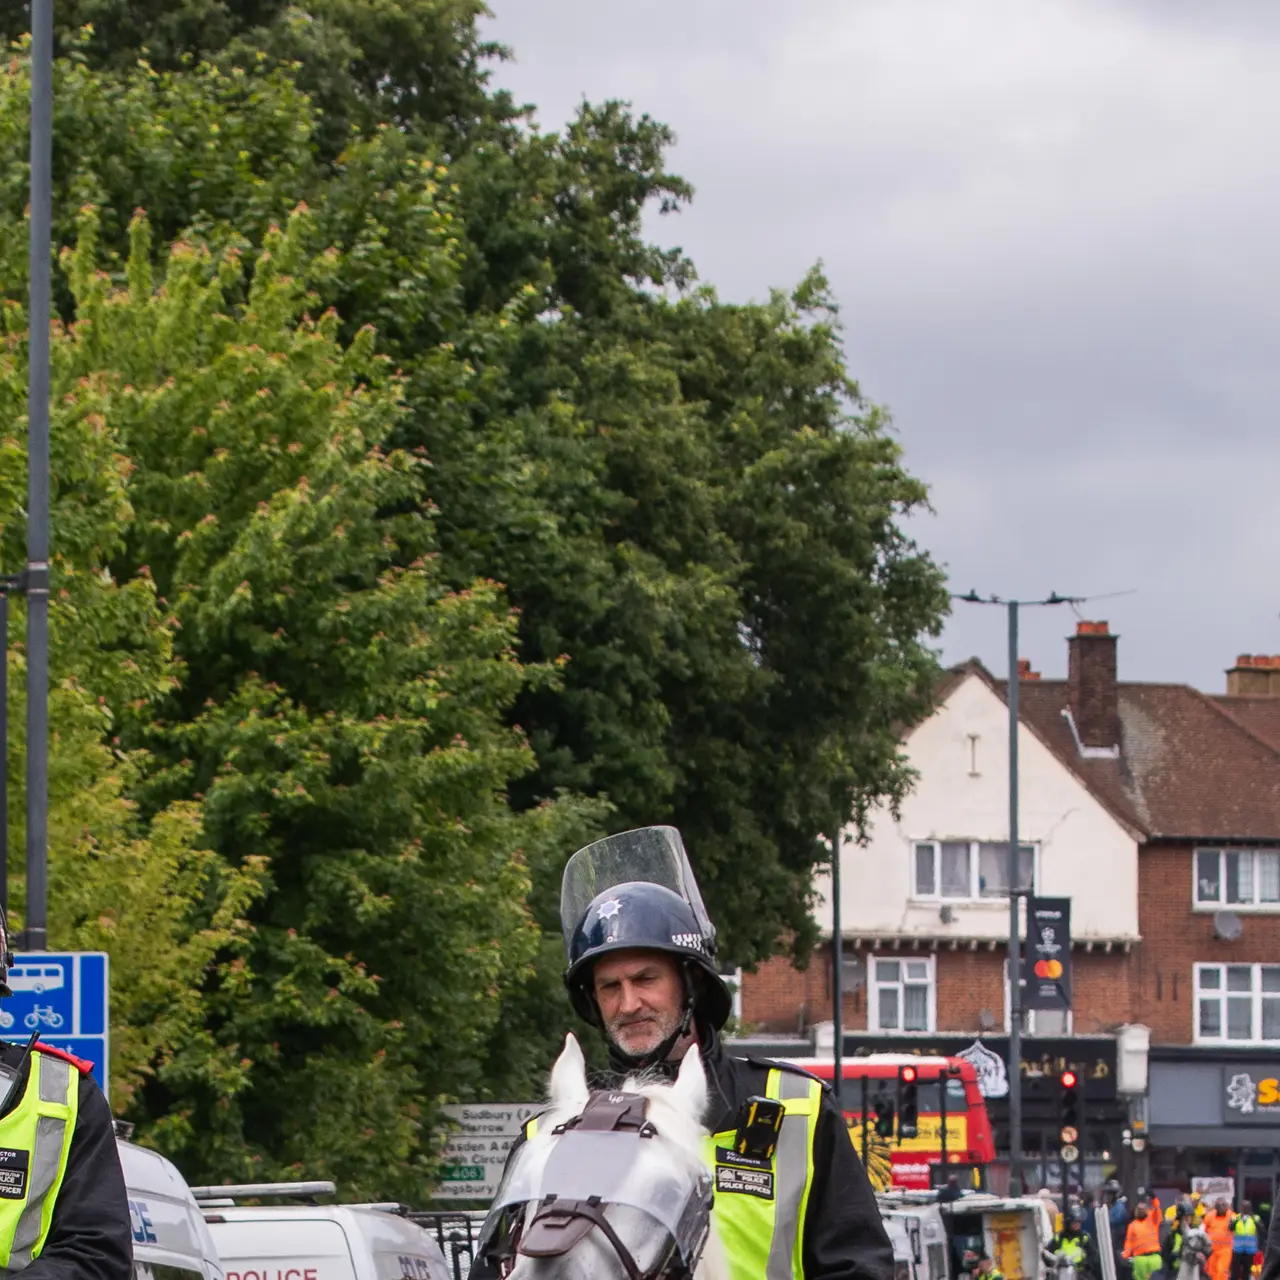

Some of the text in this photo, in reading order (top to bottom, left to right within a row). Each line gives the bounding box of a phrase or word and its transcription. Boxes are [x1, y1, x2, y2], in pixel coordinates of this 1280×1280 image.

[462, 1109, 513, 1121] Sudbury
[439, 1183, 493, 1195] ingsbury
[719, 1181, 771, 1195] POLICE OFFICER
